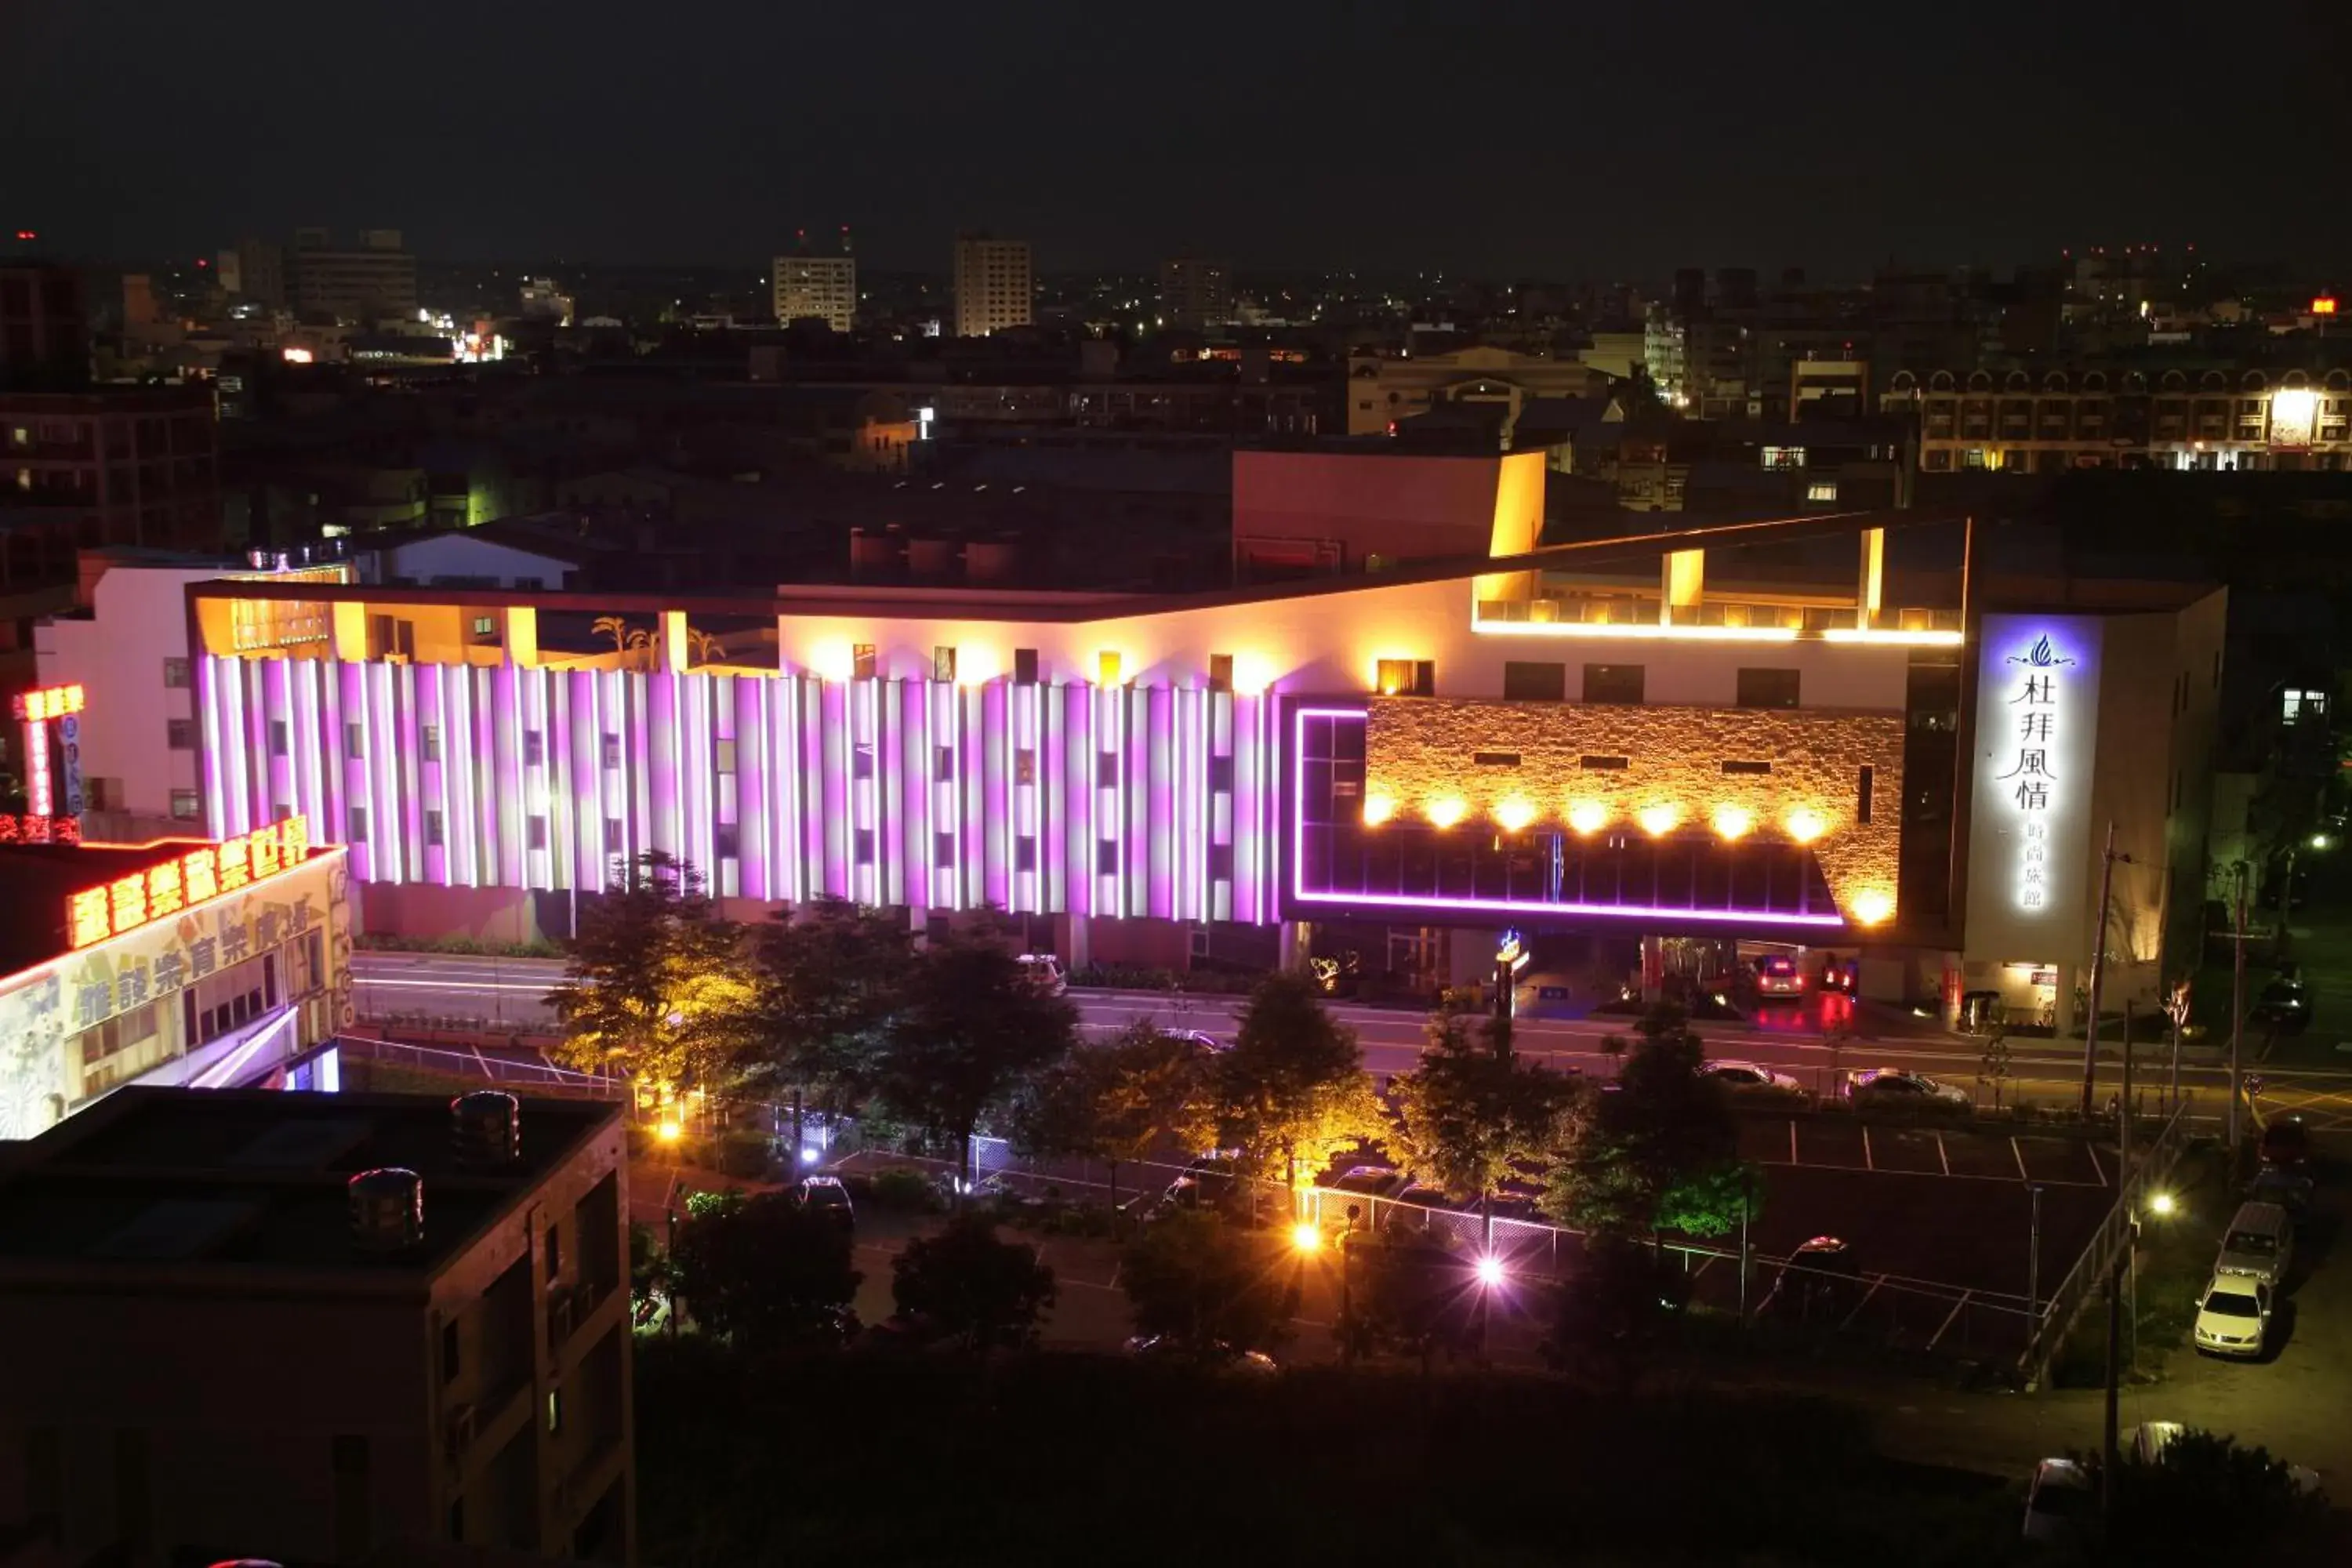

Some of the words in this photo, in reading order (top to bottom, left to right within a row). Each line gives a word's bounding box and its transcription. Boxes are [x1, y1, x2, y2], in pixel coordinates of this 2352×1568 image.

[1996, 675, 2056, 810] 杜拜風情
[2022, 822, 2045, 907] 時尚旅館
